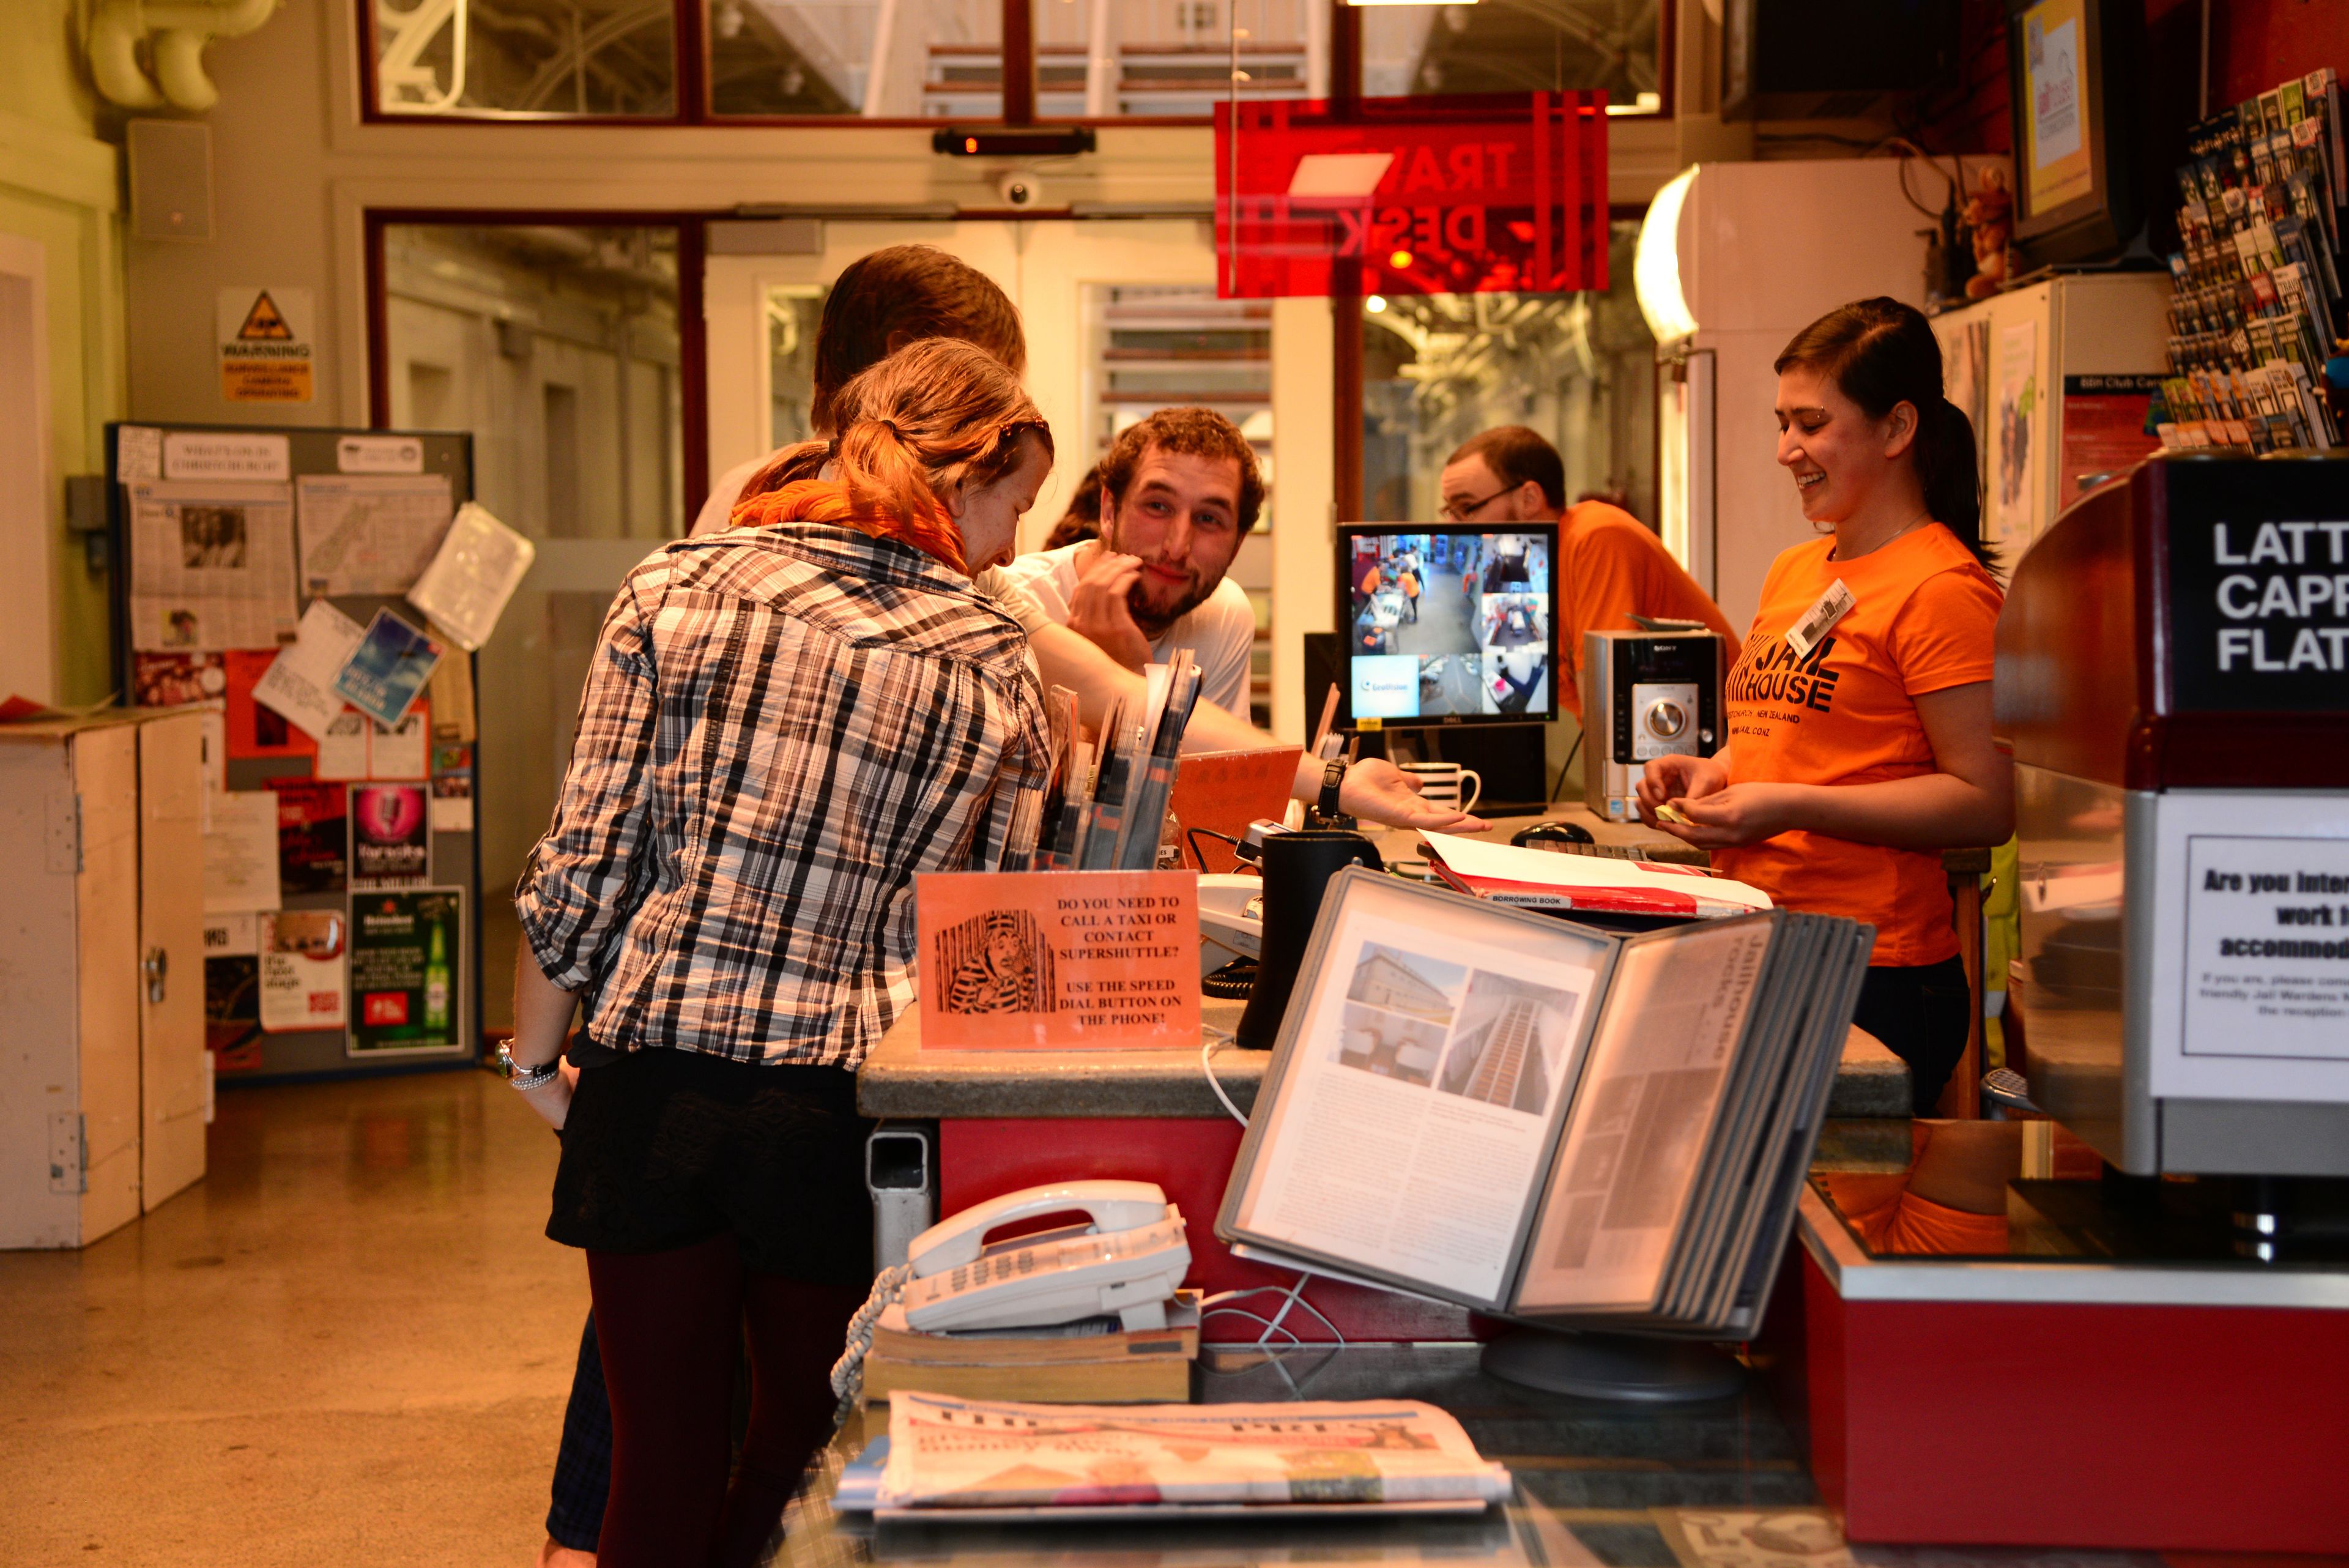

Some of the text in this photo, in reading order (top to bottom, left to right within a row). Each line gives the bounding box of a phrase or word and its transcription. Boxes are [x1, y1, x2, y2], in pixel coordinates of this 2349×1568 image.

[223, 343, 310, 357] WARNING
[2217, 628, 2349, 671] FLAT
[1755, 636, 1839, 682] JAIL
[1372, 683, 1408, 691] GeoVision
[1745, 673, 1835, 713] HOUSE
[1757, 710, 1768, 718] NEW
[1769, 710, 1800, 724] ZEALAND
[2203, 869, 2243, 891] Are
[2248, 874, 2290, 894] you
[1058, 896, 1179, 910] DO YOU NEED TO
[1061, 913, 1176, 926] CALL A TAXI OR
[2276, 904, 2333, 926] work
[1083, 931, 1154, 942] CONTACT
[1059, 946, 1179, 959] SUPERSHUTTLE?
[1066, 980, 1175, 993] USE THE SPEED
[2215, 975, 2238, 986] you
[2271, 975, 2314, 986] please
[1714, 934, 1763, 1060] Jailhouse
[2200, 989, 2248, 1001] friendly
[2254, 990, 2276, 1000] Jail
[2280, 990, 2338, 1001] Wardens
[1059, 996, 1182, 1009] DIAL BUTTON ON
[2258, 1006, 2279, 1016] the
[1078, 1013, 1165, 1025] THE PHONE!
